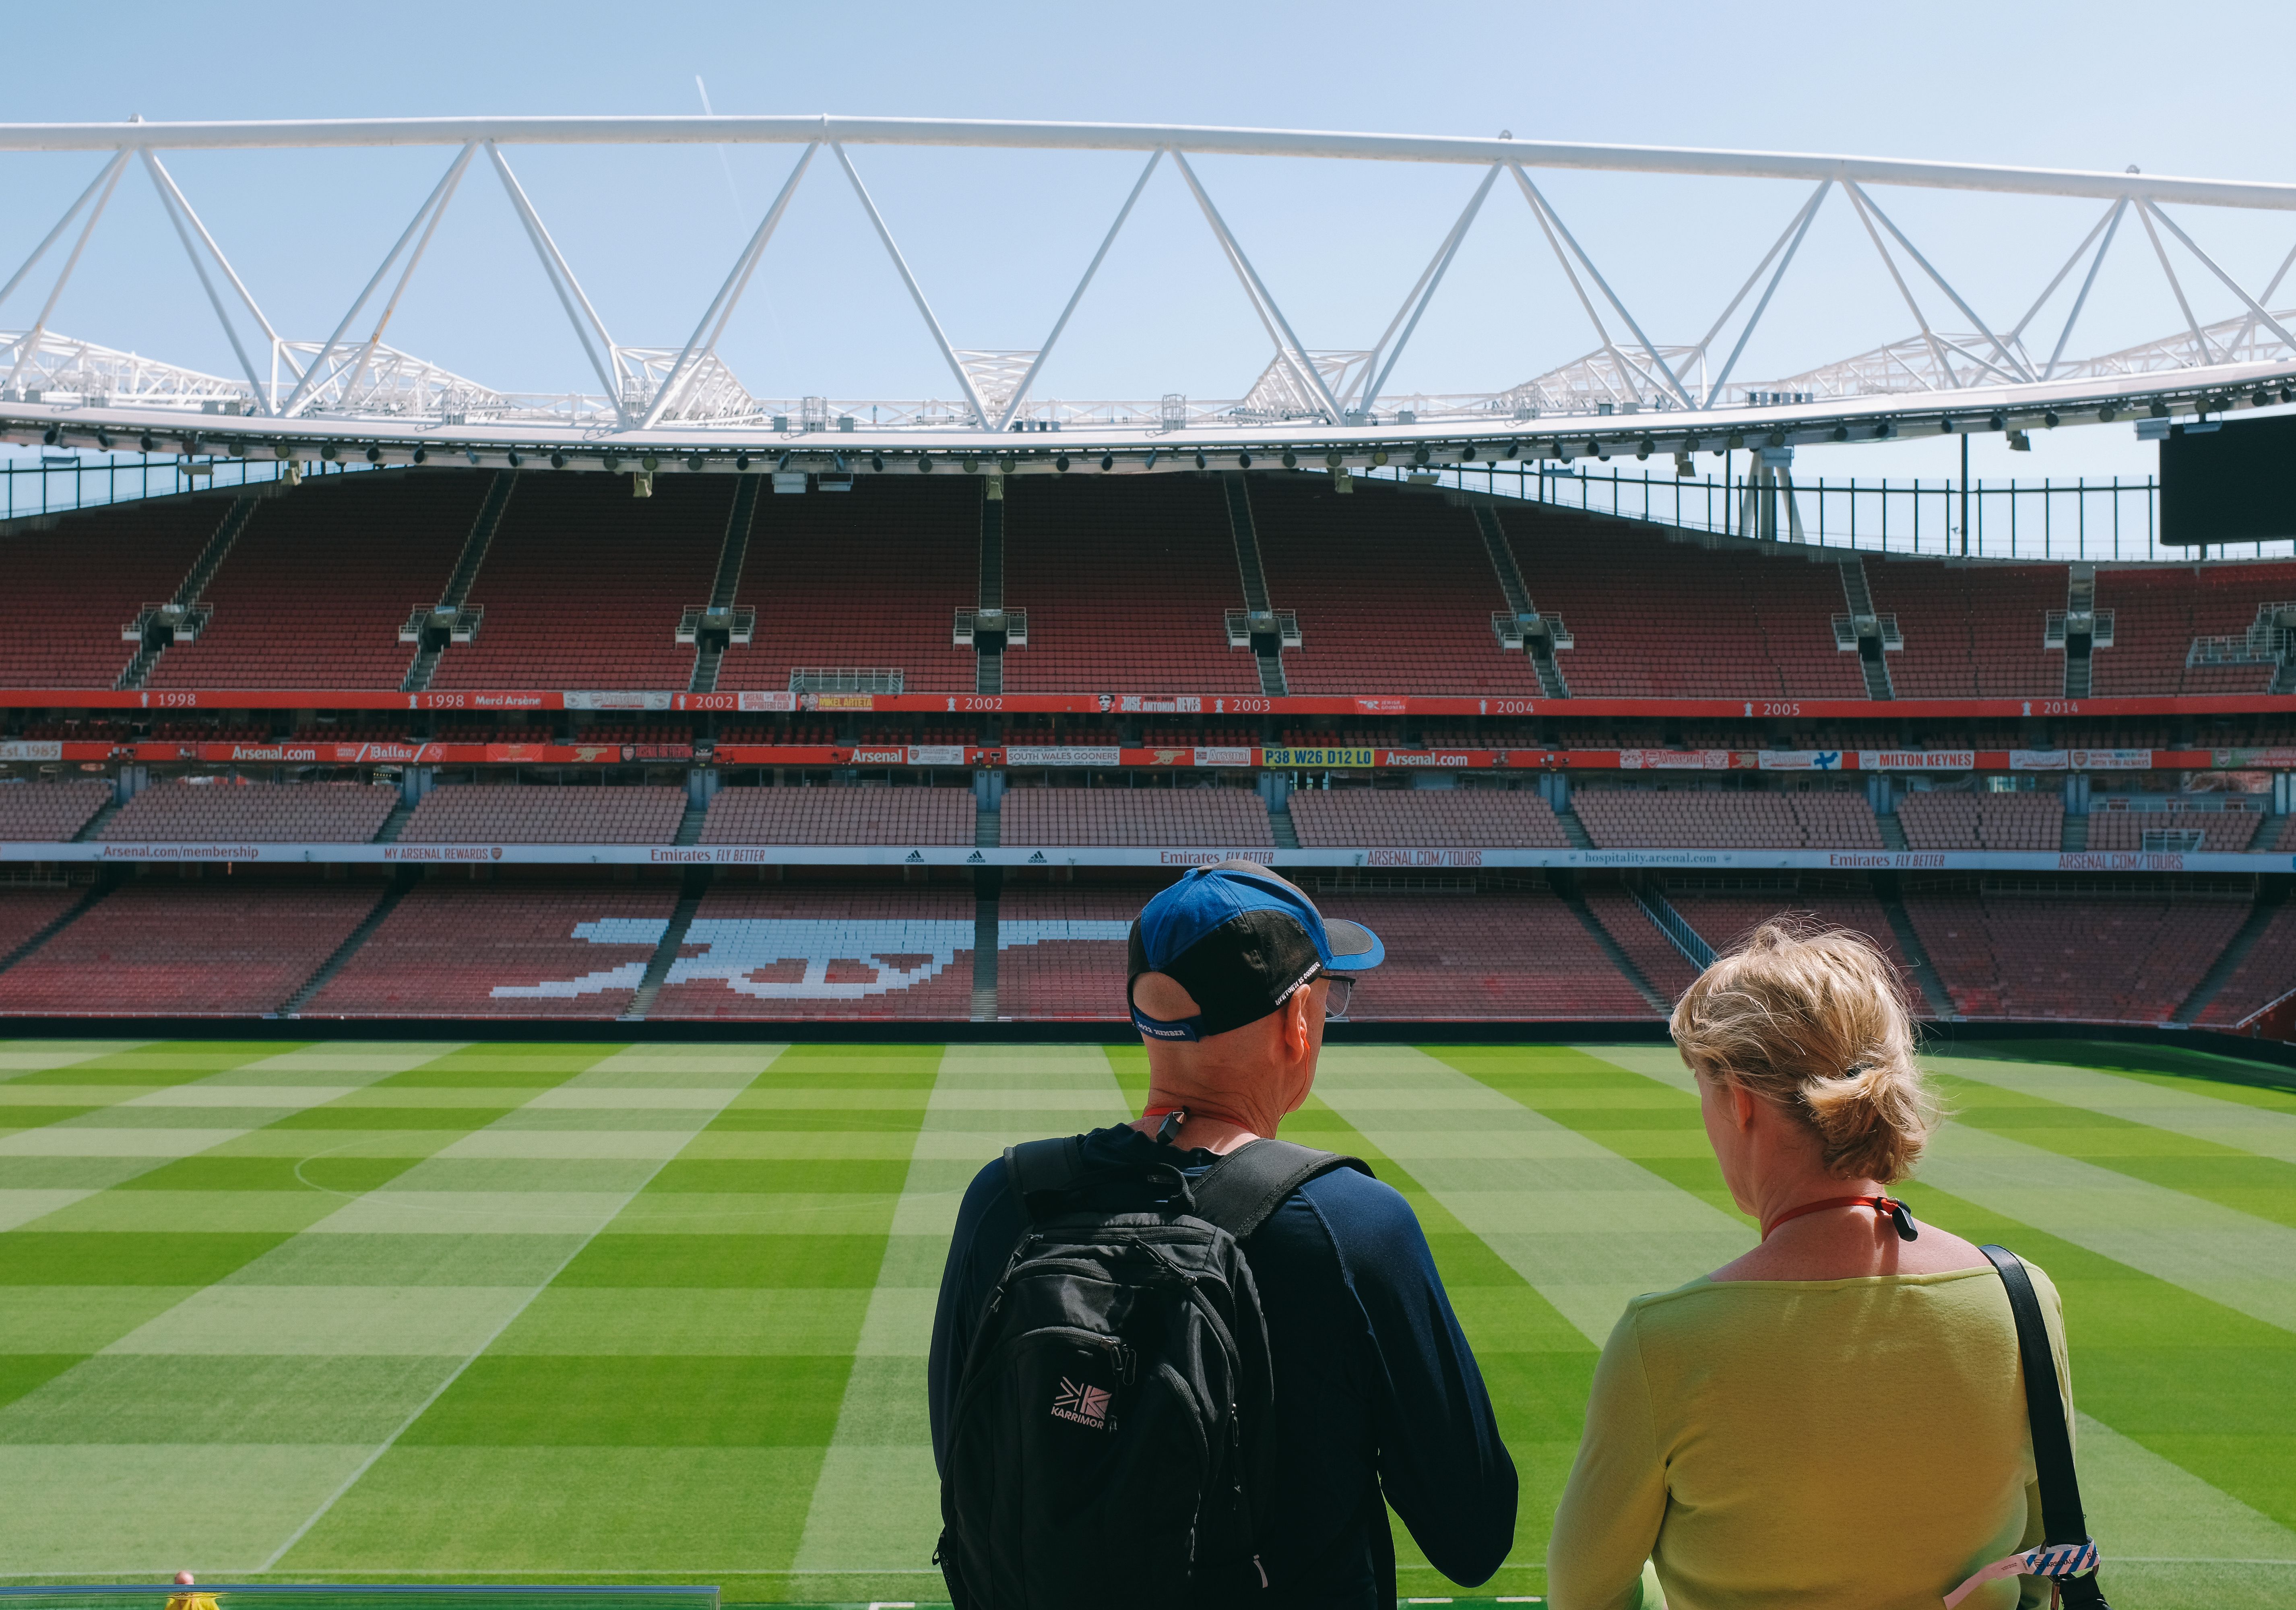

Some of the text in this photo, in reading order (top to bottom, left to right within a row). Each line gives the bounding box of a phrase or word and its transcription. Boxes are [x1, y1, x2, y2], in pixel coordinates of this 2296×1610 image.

[159, 694, 196, 706] 1998
[427, 695, 464, 707] 1998
[475, 695, 503, 706] Merci
[696, 696, 733, 708] 2002
[819, 698, 872, 707] MIKEL ARTETA
[965, 698, 1002, 710] 2002
[1121, 696, 1201, 712] JOSE ANTONIO REYES
[1233, 700, 1270, 711] 2003
[1497, 701, 1534, 713] 2004
[1763, 703, 1800, 715] 2005
[2044, 701, 2078, 714] 2014
[232, 746, 316, 761] Arsenal.com
[370, 745, 412, 759] Dallas
[851, 749, 902, 763] Arsenal
[1074, 752, 1118, 760] GOONERS
[1208, 749, 1249, 760] Arsenal
[1265, 750, 1289, 764] P38
[1295, 750, 1323, 764] W26
[1328, 750, 1352, 764] D12
[1386, 752, 1468, 766] Arsenal.com
[1879, 754, 1971, 766] MILTON KEYNES
[103, 846, 259, 859] Arsenal.com/membership
[384, 848, 488, 859] MY ARSENAL REWARDS
[650, 849, 765, 861] Emirates FLY BETTER
[1160, 851, 1220, 863] Emirates
[1367, 850, 1482, 865] ARSENAL.COM/TOURS
[1585, 852, 1716, 865] hospitality.arsenal.com
[1829, 854, 1945, 867] Emirates FLY BETTER
[1298, 976, 1304, 985] IS
[1051, 1406, 1104, 1429] KARRIMOR
[2047, 1558, 2072, 1567] ARSENAL
